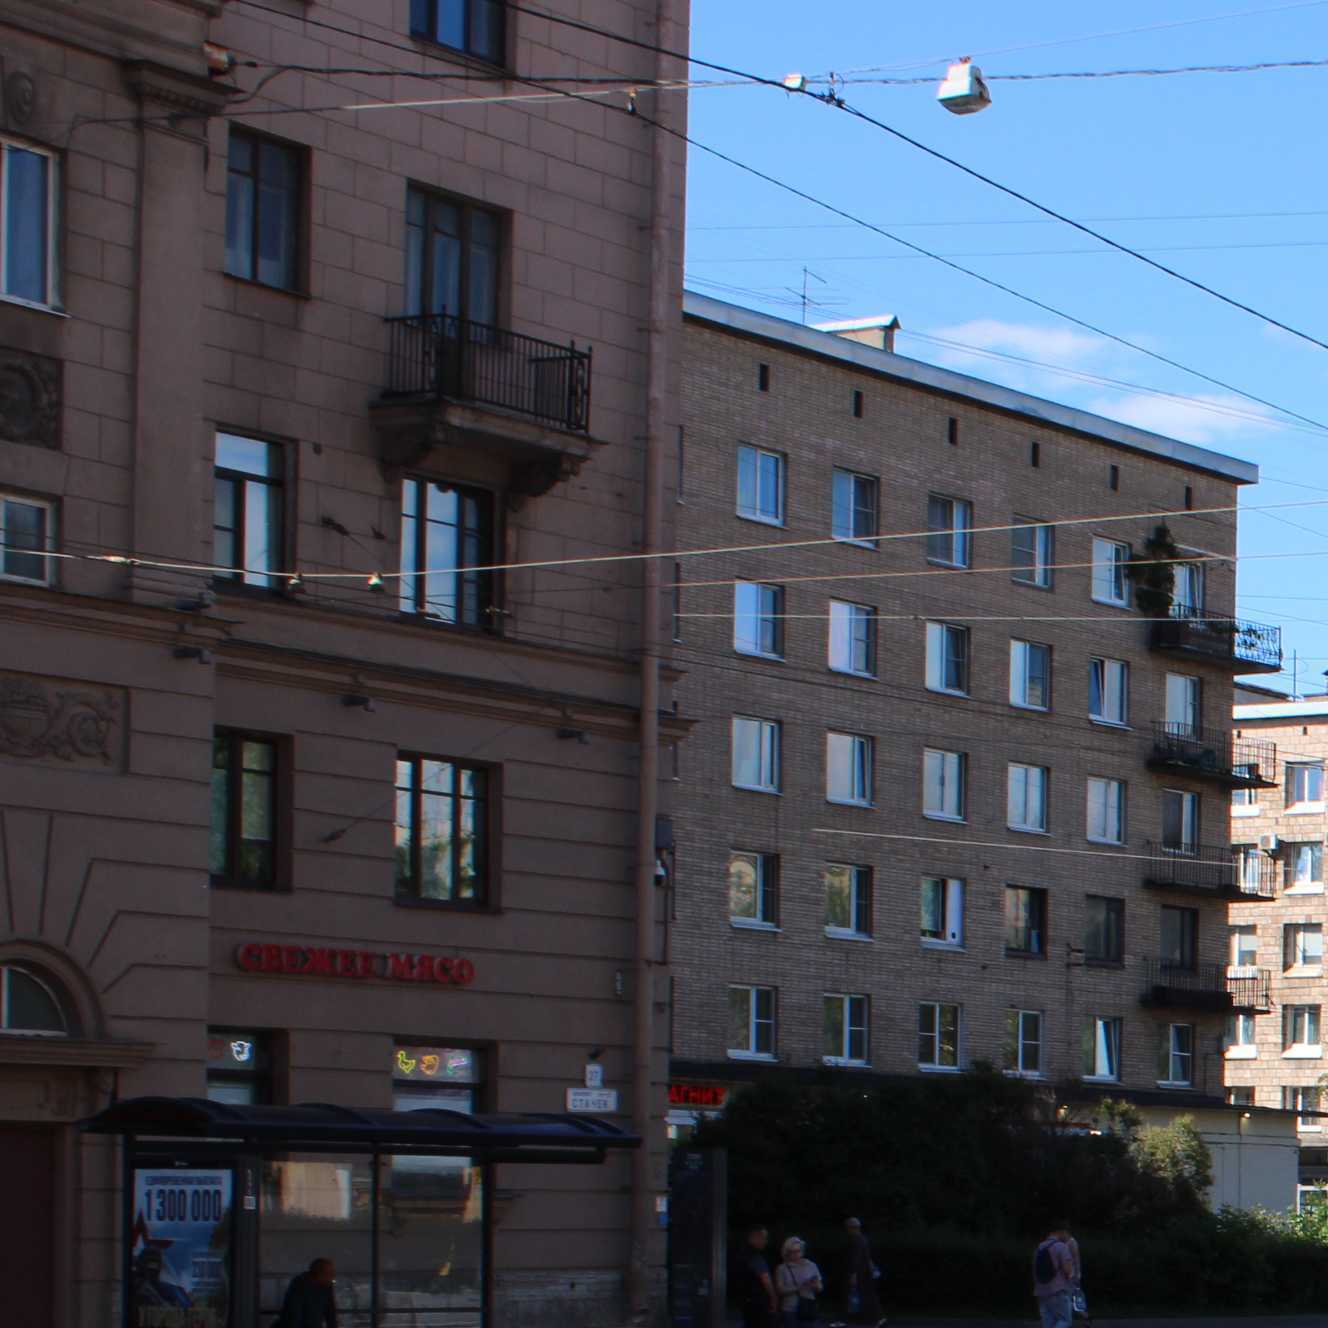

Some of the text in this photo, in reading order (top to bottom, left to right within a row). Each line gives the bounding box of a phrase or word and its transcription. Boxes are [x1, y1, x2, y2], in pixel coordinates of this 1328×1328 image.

[239, 943, 476, 985] СВЕЖЕЕ МЯСО
[668, 1083, 727, 1106] АГНИТ
